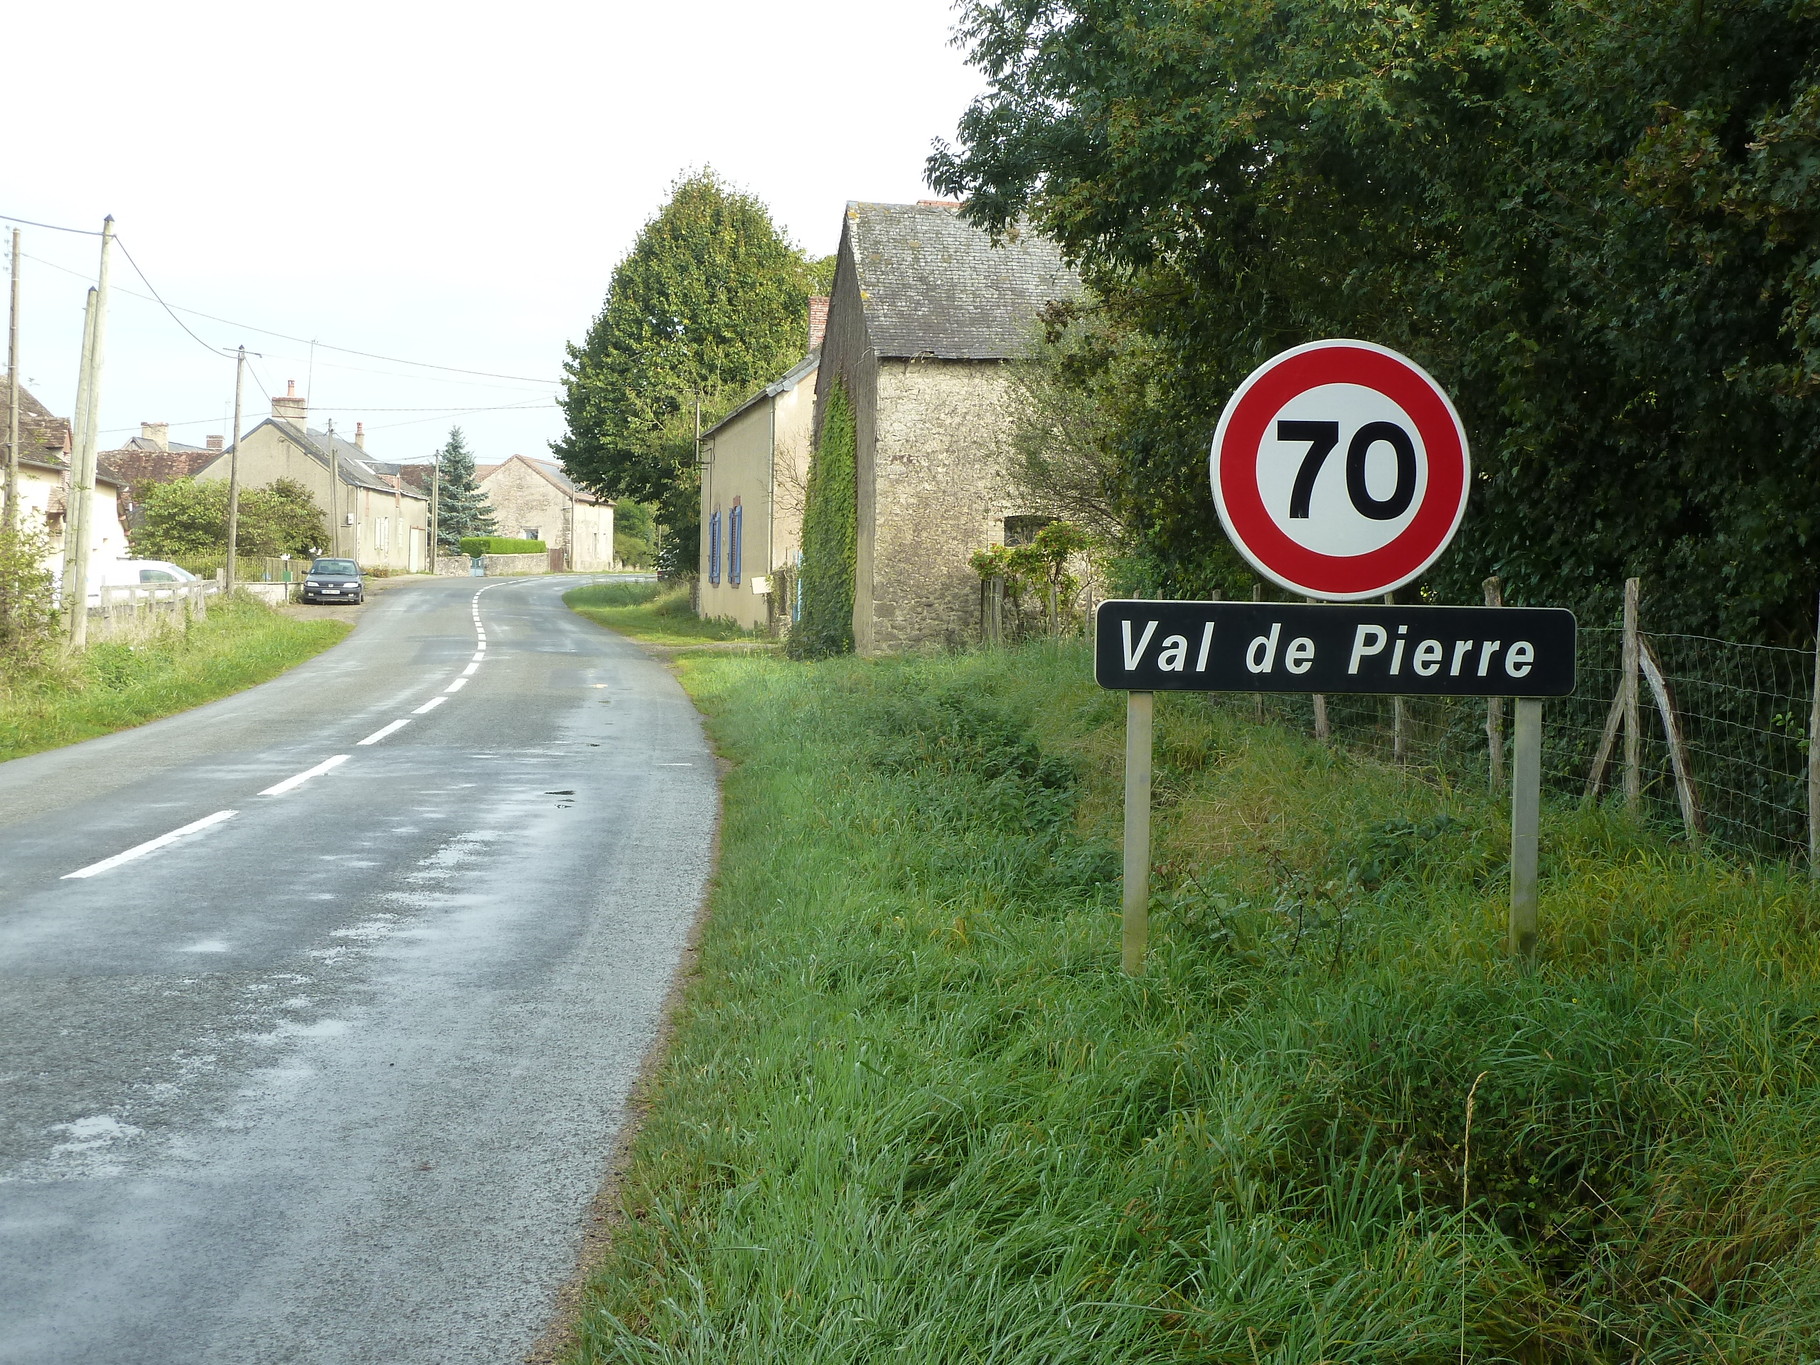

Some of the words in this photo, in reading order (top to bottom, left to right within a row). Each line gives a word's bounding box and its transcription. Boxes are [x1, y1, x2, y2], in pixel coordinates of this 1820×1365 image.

[1276, 419, 1417, 521] 70
[1121, 620, 1215, 672] Val
[1245, 622, 1315, 675] de
[1347, 624, 1535, 678] Pierre
